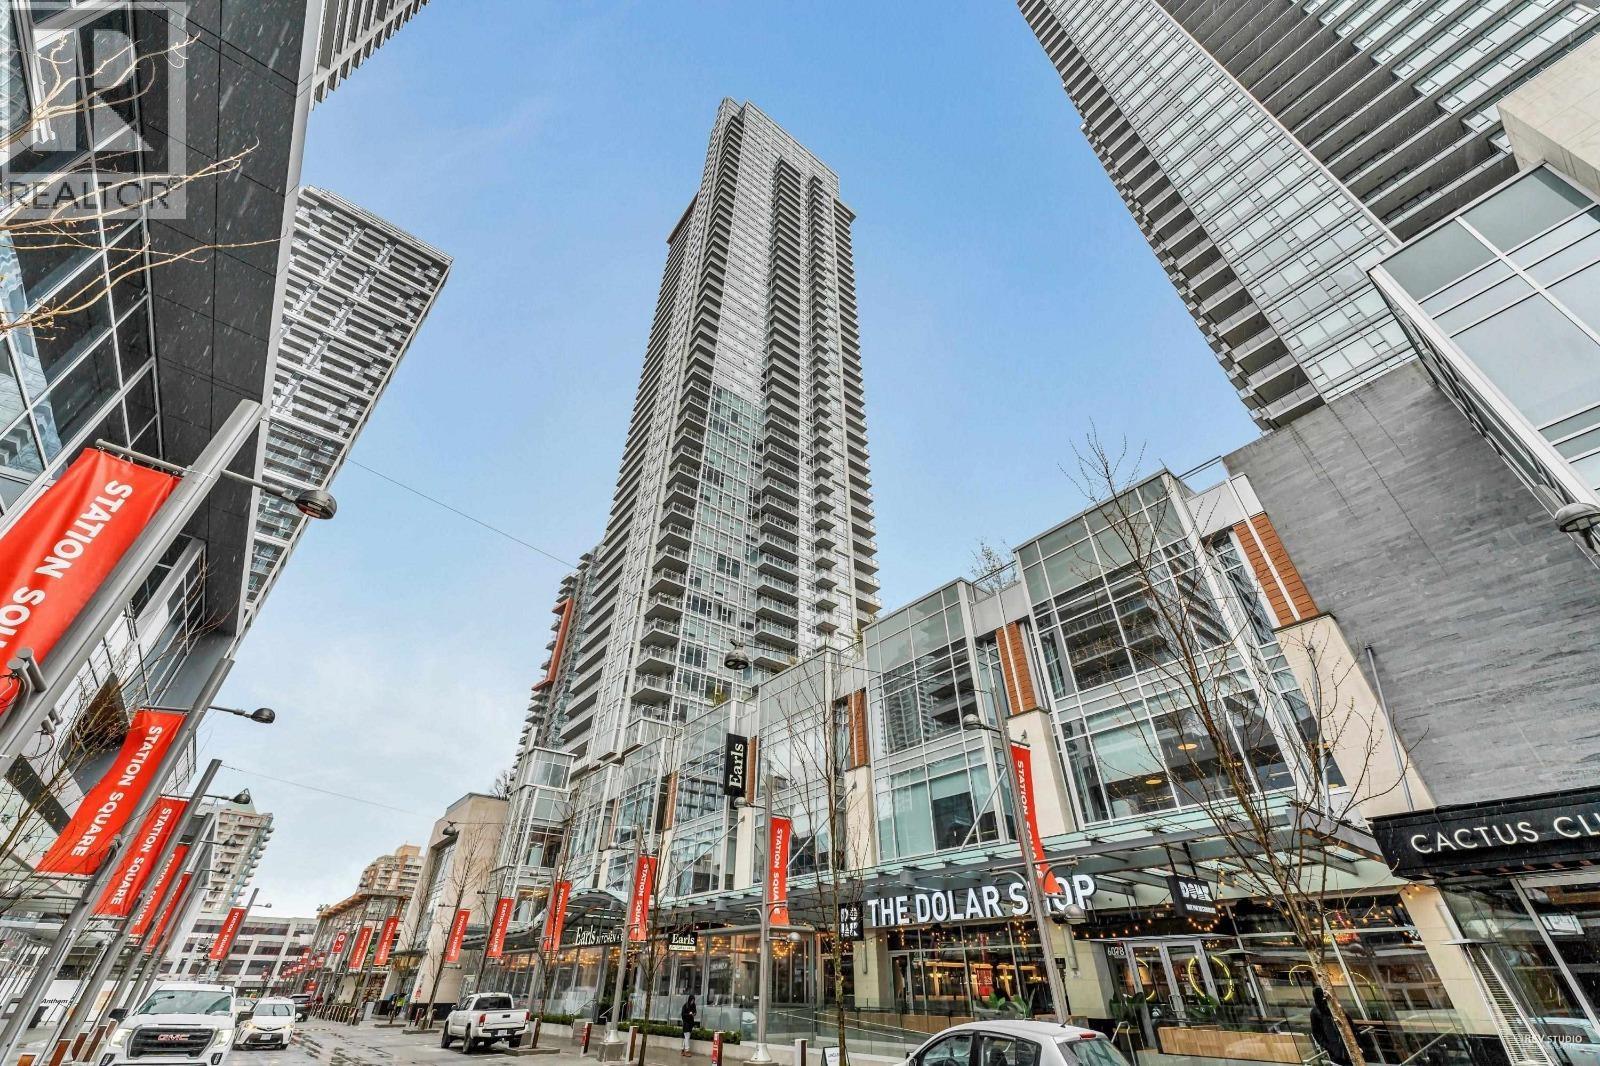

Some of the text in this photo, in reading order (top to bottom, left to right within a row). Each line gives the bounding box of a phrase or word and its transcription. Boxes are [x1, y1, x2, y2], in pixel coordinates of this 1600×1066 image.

[35, 480, 133, 580] STATION
[728, 742, 744, 789] Earls
[71, 725, 163, 857] STATION SQUARE
[1017, 760, 1028, 815] STATION
[141, 808, 172, 853] STATION
[773, 828, 783, 869] STATION
[1410, 821, 1540, 854] CACTUS
[110, 857, 144, 905] SQUARE
[639, 864, 649, 897] STATION
[867, 895, 911, 927] THE
[916, 885, 1002, 922] DOLAR
[574, 924, 596, 945] Earls
[672, 933, 695, 945] Earls
